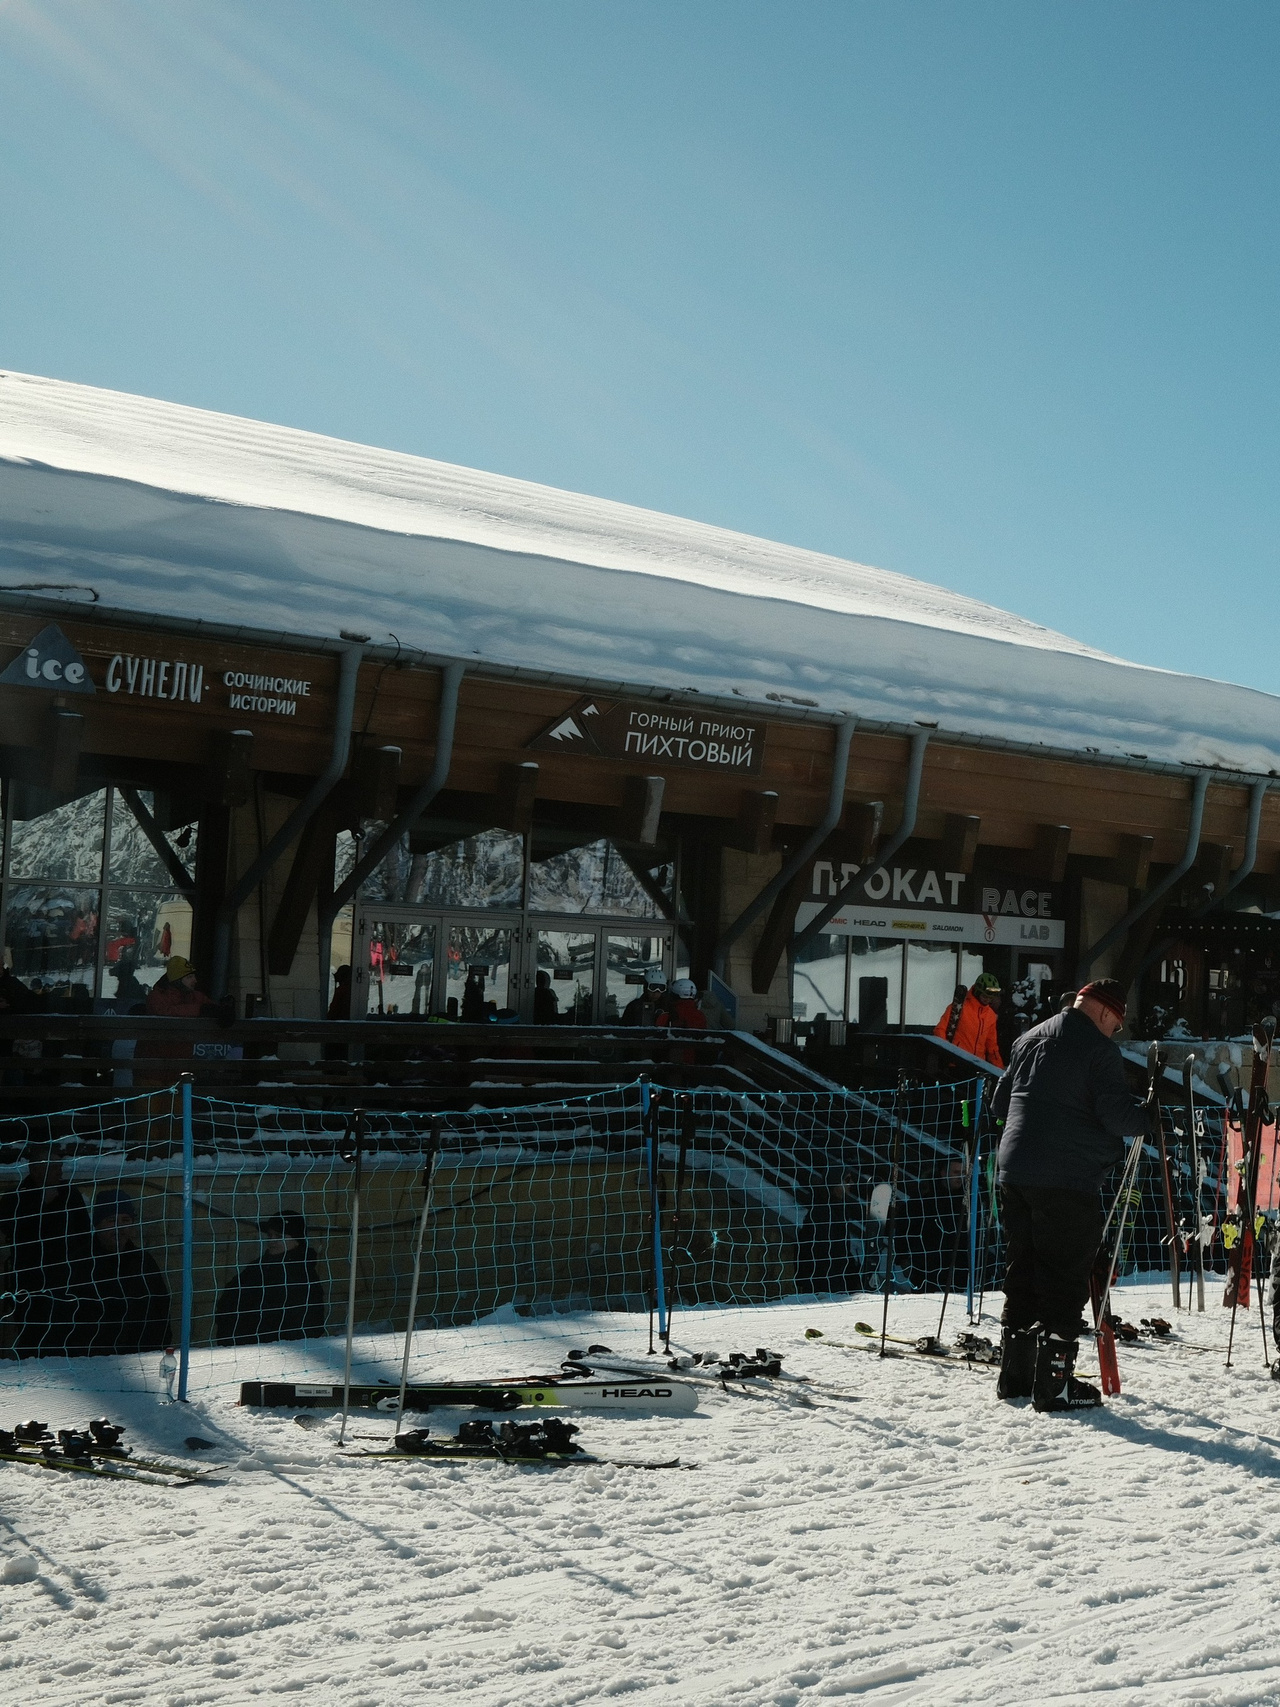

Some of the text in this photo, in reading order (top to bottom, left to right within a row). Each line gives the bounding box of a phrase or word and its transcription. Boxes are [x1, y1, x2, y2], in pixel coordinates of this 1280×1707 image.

[26, 648, 85, 684] ice
[105, 654, 204, 703] СУНЕЛИ
[222, 670, 312, 697] СОЧИНСКИЕ
[229, 693, 297, 716] ИСТОРИИ
[629, 711, 755, 742] ГОРНЫЙ ПРИЮТ
[624, 731, 753, 767] ПИХТОВЫЙ
[982, 887, 1052, 917] RACE
[853, 918, 886, 928] HEAD
[932, 924, 964, 932] SALOMON
[1020, 924, 1050, 941] LAB
[602, 1388, 673, 1398] HEAD
